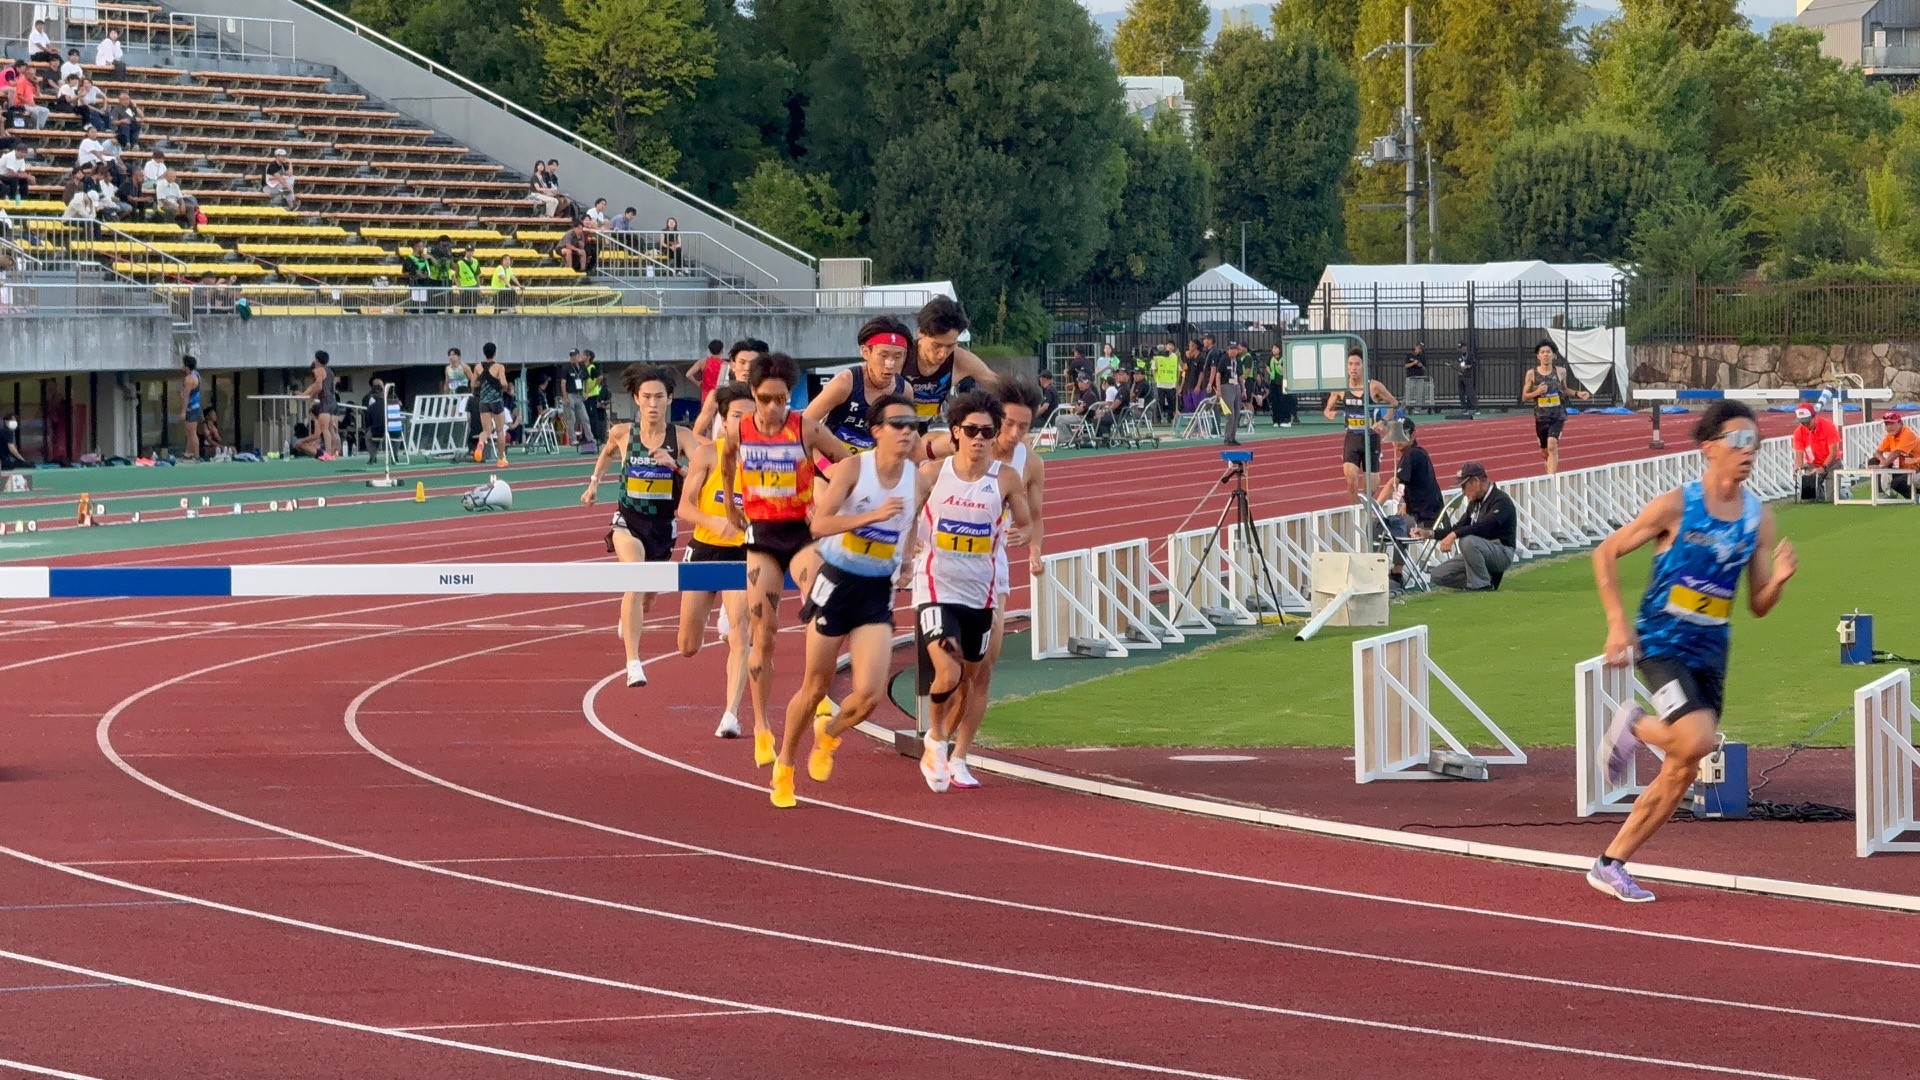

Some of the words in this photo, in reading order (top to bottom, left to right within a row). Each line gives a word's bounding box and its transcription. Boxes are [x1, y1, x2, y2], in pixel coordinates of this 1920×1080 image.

[844, 415, 869, 427] 戸上
[644, 479, 654, 493] 7
[758, 471, 780, 487] 12
[865, 541, 872, 555] 1
[951, 536, 974, 552] 11
[439, 574, 474, 585] NISHI
[1695, 596, 1713, 614] 2
